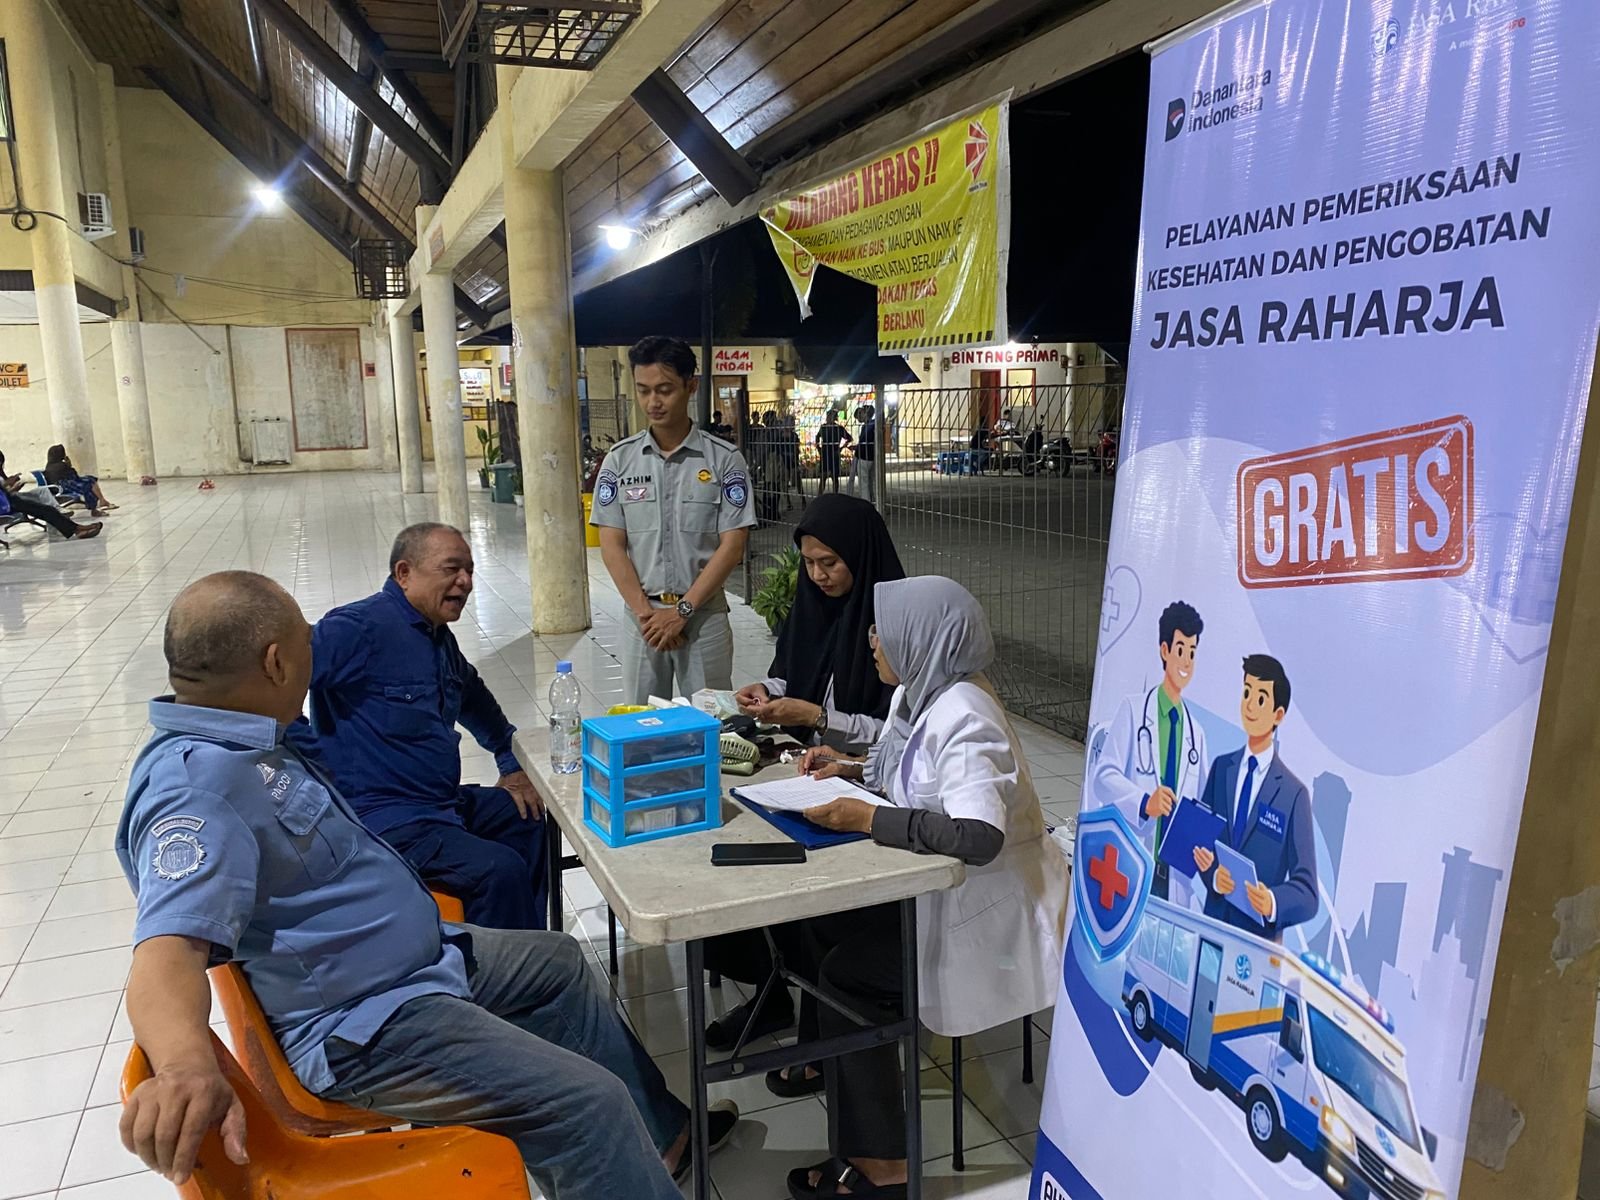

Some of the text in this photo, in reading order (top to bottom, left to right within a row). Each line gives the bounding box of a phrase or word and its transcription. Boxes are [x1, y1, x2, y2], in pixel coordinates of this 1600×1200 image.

[1191, 69, 1271, 109] Danantara
[784, 171, 859, 232] DILARANG
[861, 146, 921, 209] KERAS
[1165, 152, 1521, 249] PELAYANAN PEMERIKSAAN
[829, 226, 845, 244] DAN
[845, 216, 884, 241] PEDAGANG
[882, 201, 922, 230] ASONGAN
[887, 226, 927, 252] MAUPUN
[927, 219, 952, 242] NAIK
[951, 216, 963, 236] KE
[887, 257, 911, 279] ATAU
[1147, 206, 1552, 293] KESEHATAN DAN PENGOBATAN
[883, 308, 925, 332] BERLAKU
[1150, 275, 1505, 350] JASA RAHARJA
[715, 350, 749, 360] ALAM
[715, 361, 753, 371] INDAH
[951, 349, 1059, 364] BINTANG PRIMA
[620, 475, 651, 487] AZHIM
[1254, 446, 1451, 567] GRATIS
